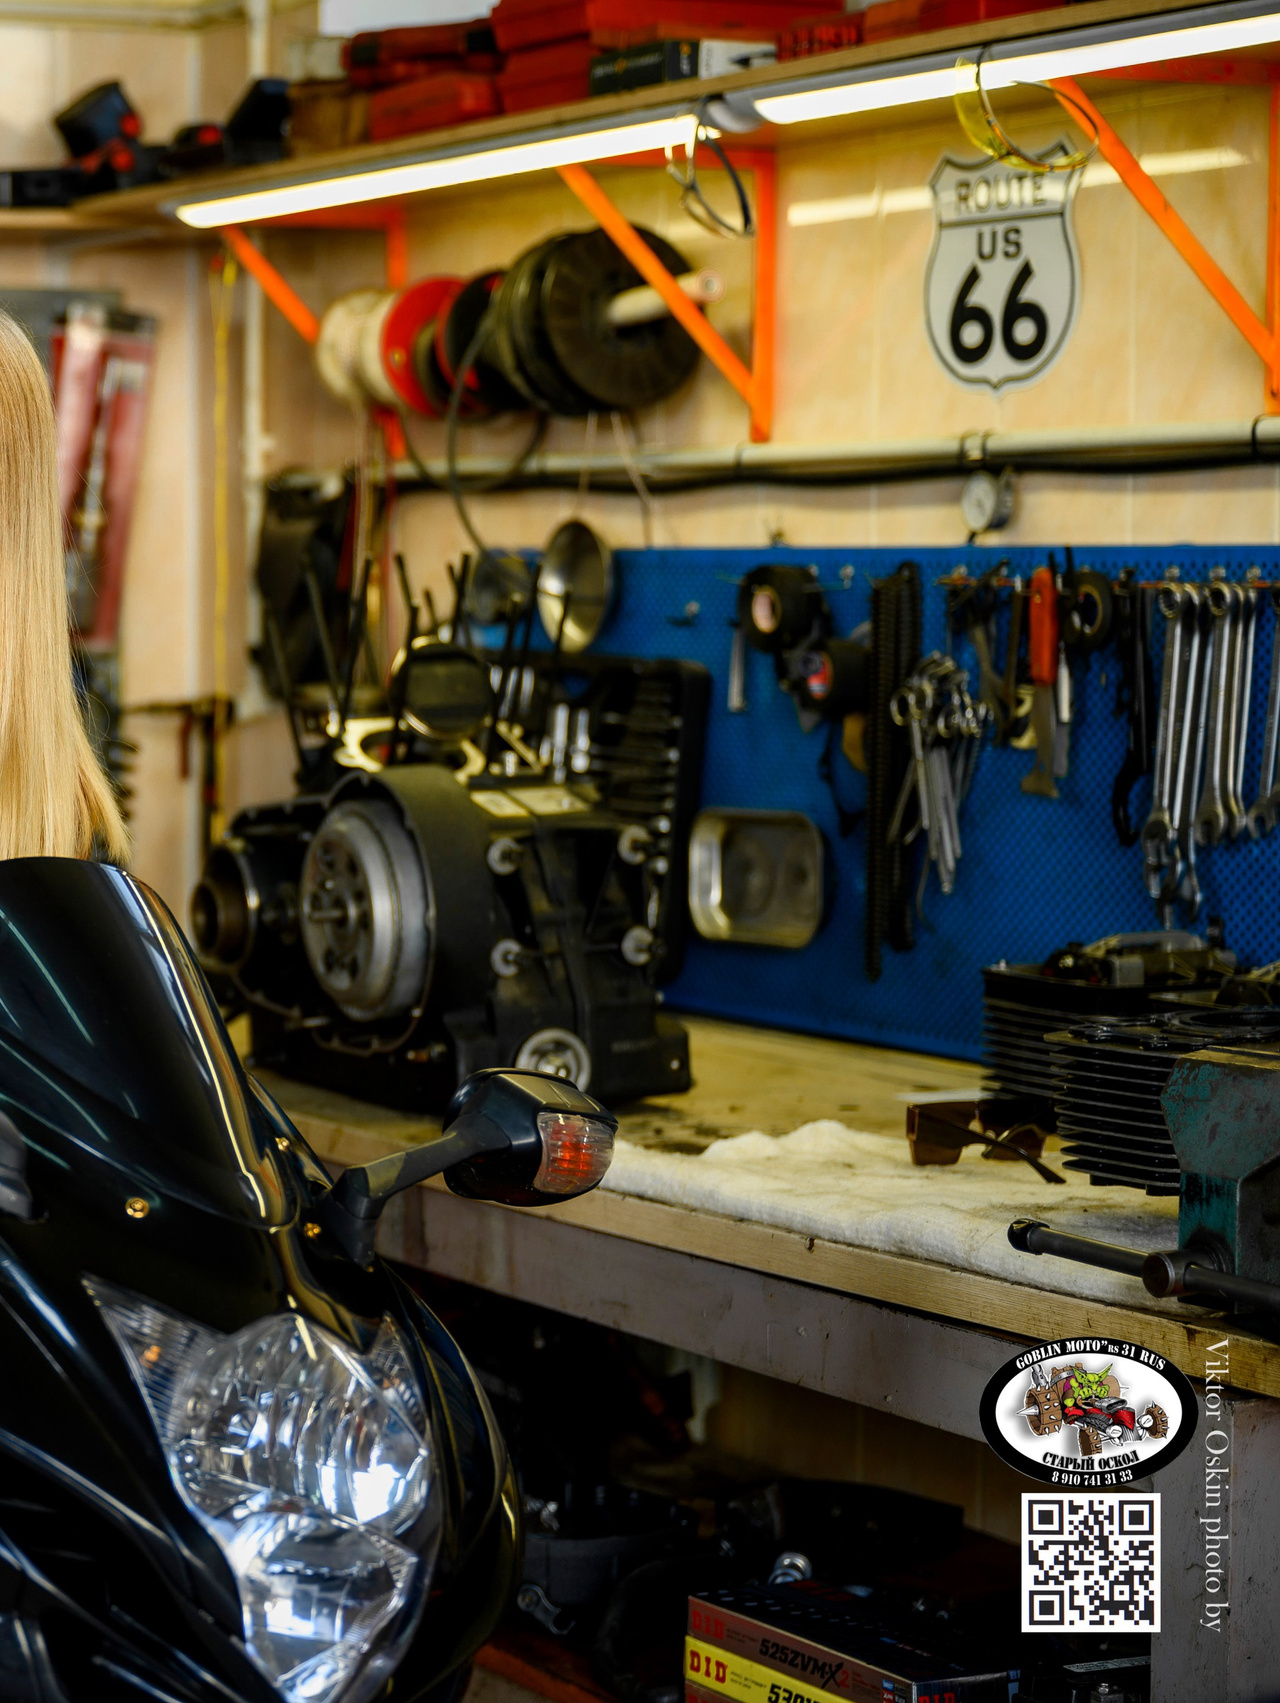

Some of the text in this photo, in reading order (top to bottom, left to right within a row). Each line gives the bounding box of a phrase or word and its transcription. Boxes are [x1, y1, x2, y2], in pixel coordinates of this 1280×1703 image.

[955, 171, 1046, 213] ROUTE
[977, 227, 1022, 260] US
[949, 260, 1048, 363] 66
